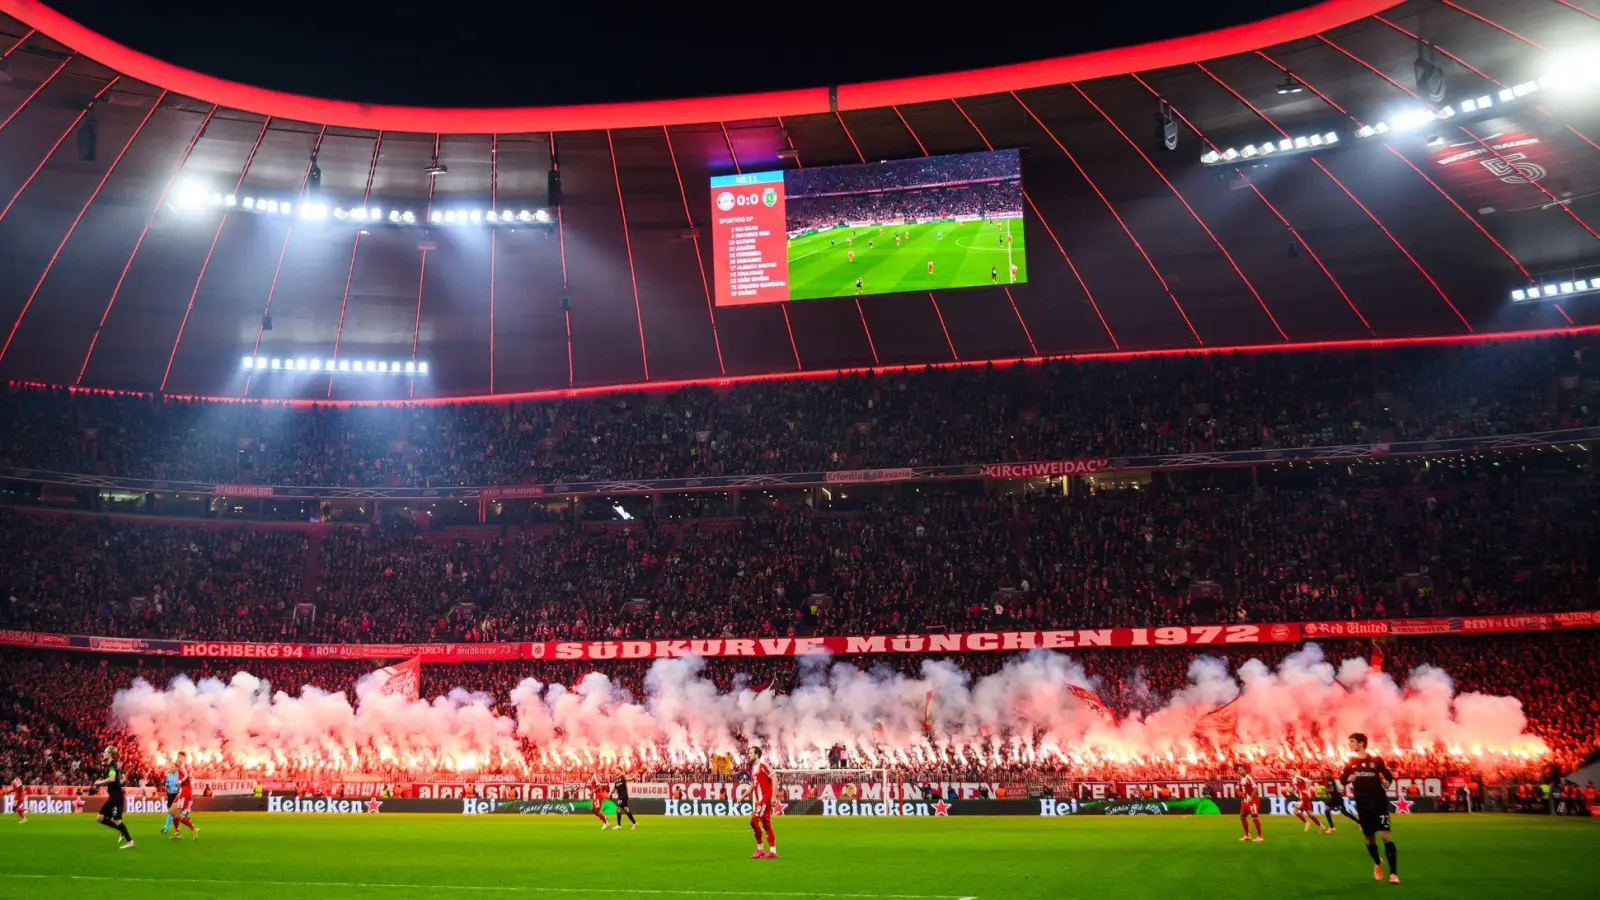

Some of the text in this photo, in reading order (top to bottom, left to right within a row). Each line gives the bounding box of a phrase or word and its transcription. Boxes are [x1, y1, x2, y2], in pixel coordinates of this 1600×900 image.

[737, 193, 759, 206] 0:0
[719, 217, 746, 225] SPORTING
[1347, 621, 1389, 634] United
[0, 631, 35, 643] ASSAU
[555, 638, 825, 660] SÜDKURVE
[846, 629, 1113, 654] MÜNCHEN
[1131, 624, 1260, 646] 1972
[183, 642, 279, 658] HÖCHBERG
[4, 796, 73, 814] Hineken
[125, 796, 169, 813] Heinek
[268, 796, 364, 814] Heineken
[664, 798, 752, 817] Heineke
[822, 798, 930, 817] Heineken
